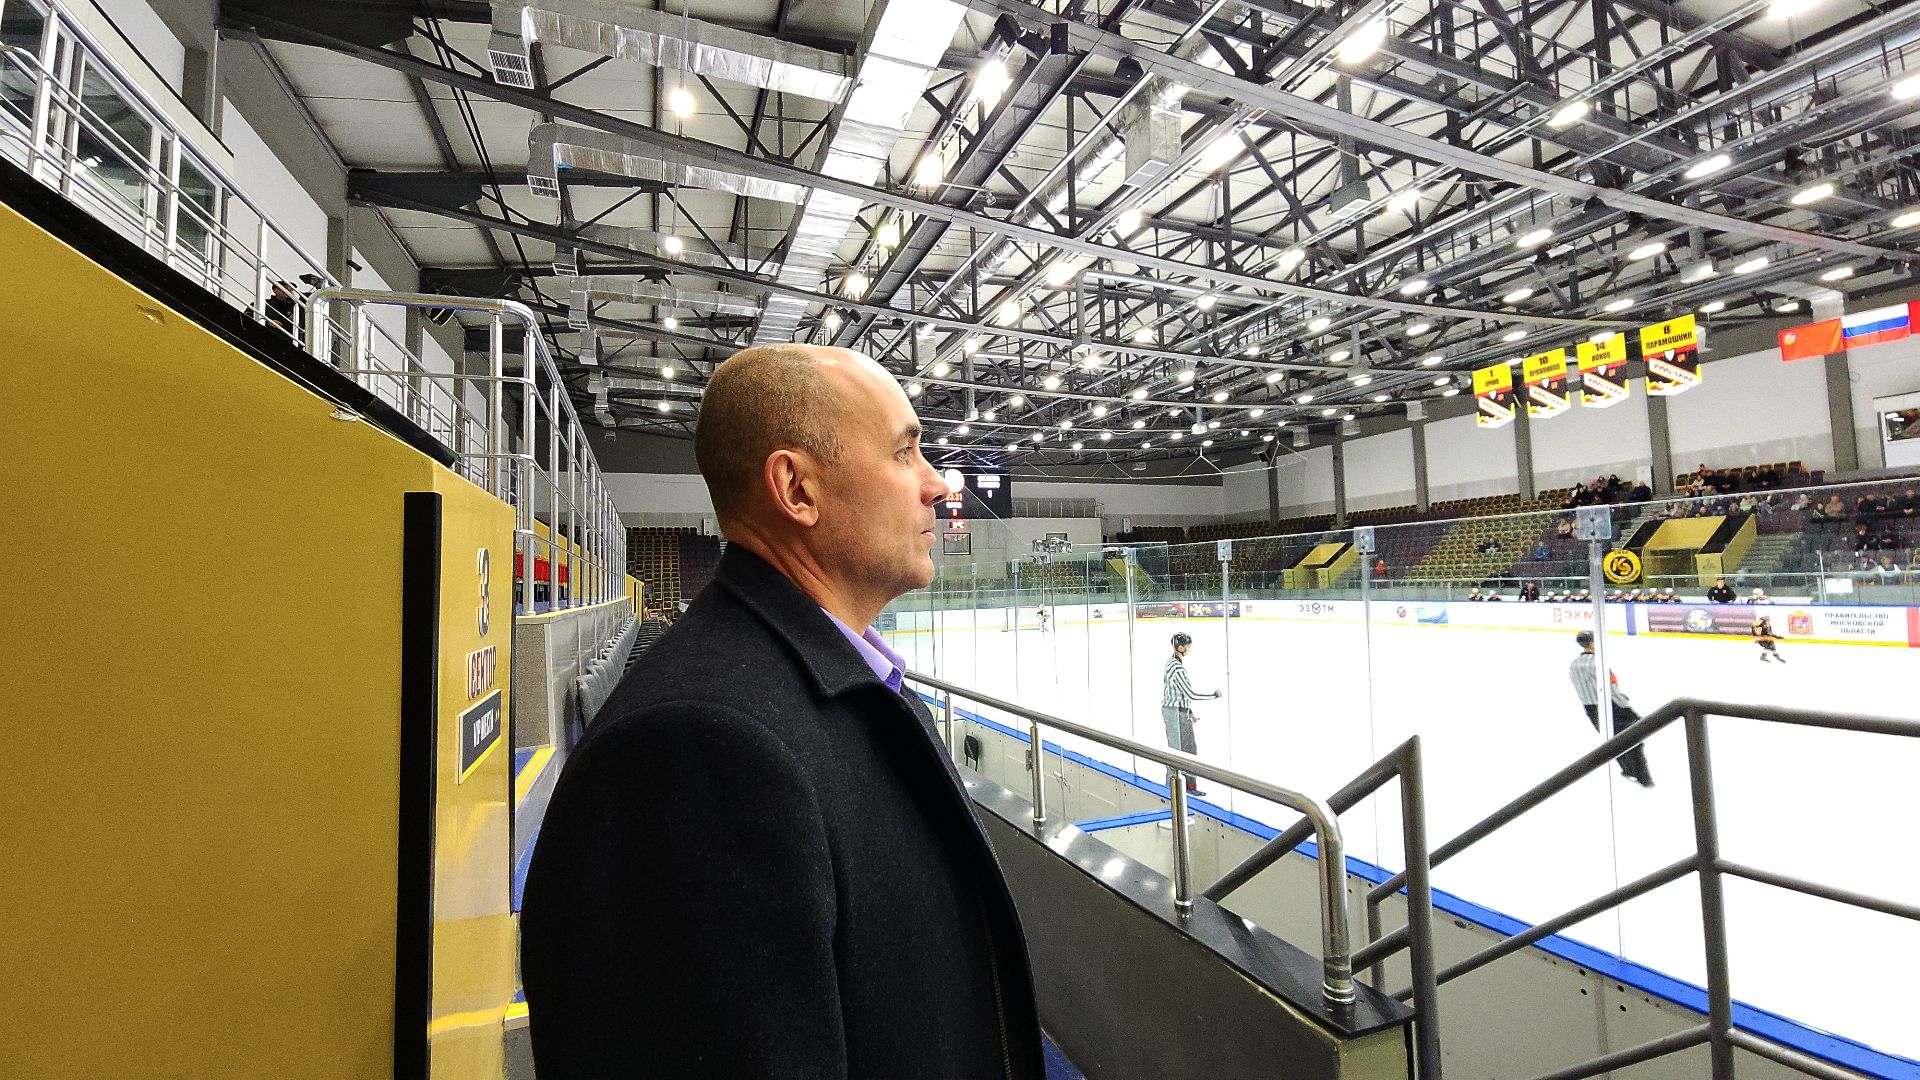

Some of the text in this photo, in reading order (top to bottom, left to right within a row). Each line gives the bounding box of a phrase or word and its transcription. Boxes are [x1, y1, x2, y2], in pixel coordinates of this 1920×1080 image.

[477, 548, 490, 636] 3
[1824, 612, 1889, 620] ПРАВИТЕЛЬСТВО
[1830, 619, 1885, 627] МОСКОВСКОЙ
[469, 645, 497, 700] СЕКТОР
